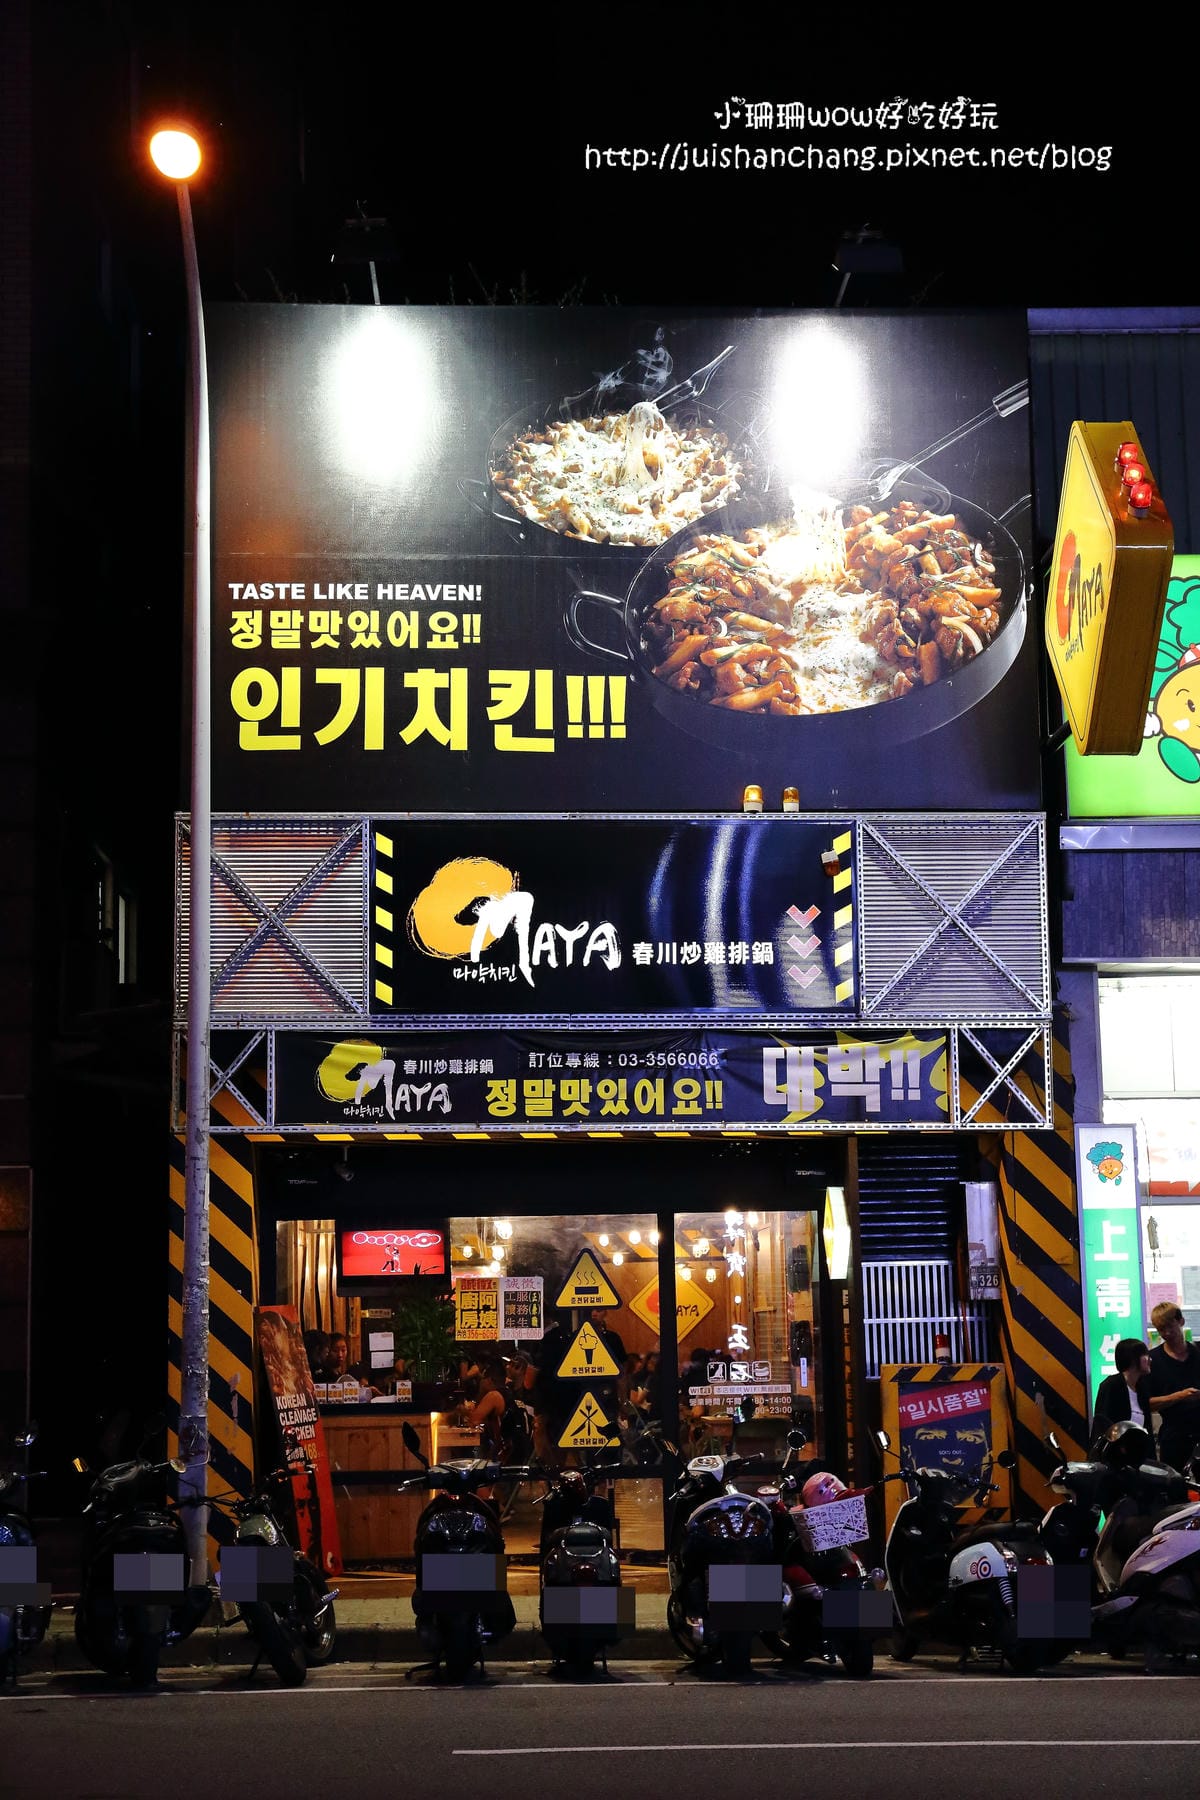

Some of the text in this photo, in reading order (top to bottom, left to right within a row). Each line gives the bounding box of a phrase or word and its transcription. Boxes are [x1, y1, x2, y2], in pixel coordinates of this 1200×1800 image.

[229, 583, 482, 601] TASTE LIKE HEAVEN!
[470, 891, 622, 987] MAYA
[632, 941, 774, 966] 春川炒雞排鍋
[453, 964, 518, 983] 마약치킨
[403, 1059, 494, 1075] 春川炒雞排鍋
[354, 1059, 452, 1120] MAYA
[979, 1274, 999, 1287] 326
[676, 1304, 699, 1317] AYA
[276, 1393, 307, 1410] KOREAN
[279, 1407, 318, 1426] CLEAVAGE
[282, 1424, 316, 1440] CKEN
